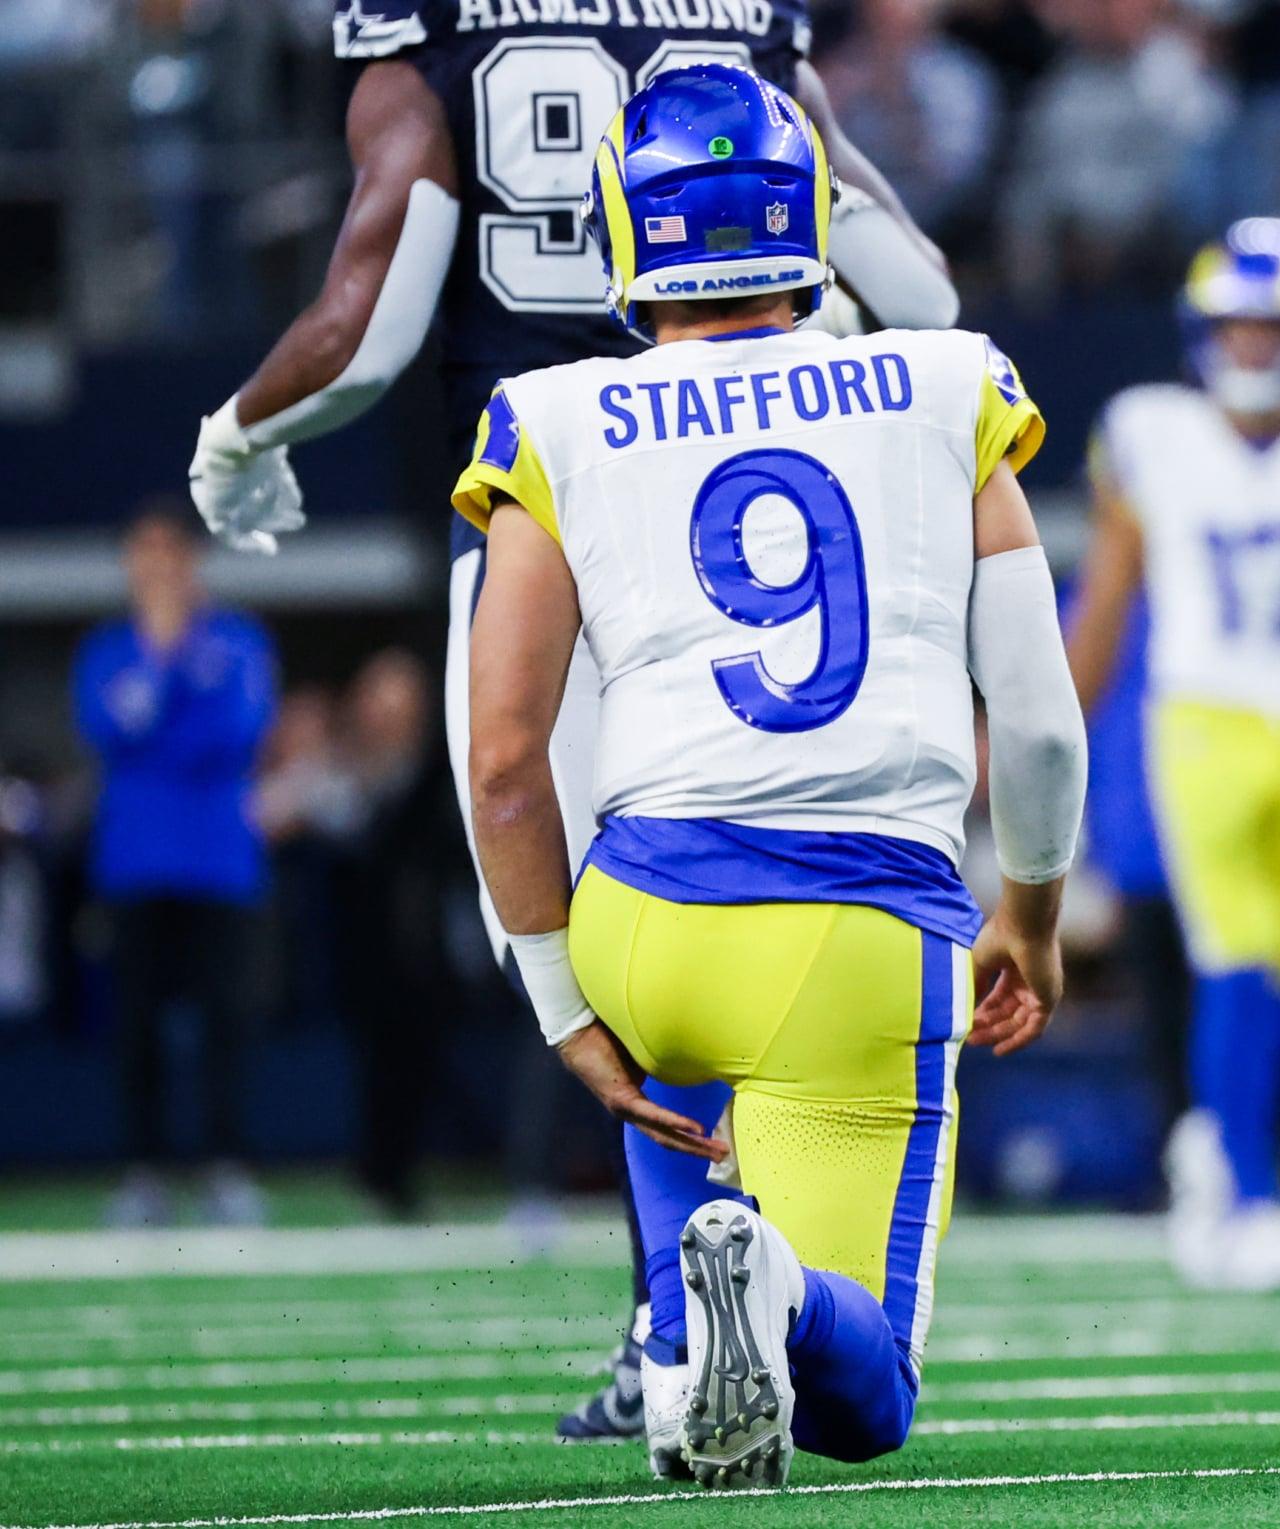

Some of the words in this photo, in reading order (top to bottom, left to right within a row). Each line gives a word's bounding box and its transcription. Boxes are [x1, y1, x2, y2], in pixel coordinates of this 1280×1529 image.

[472, 36, 752, 312] 9
[655, 281, 698, 293] LOS
[702, 270, 804, 290] ANGELES
[599, 353, 912, 449] STAFFORD
[690, 449, 869, 733] 9
